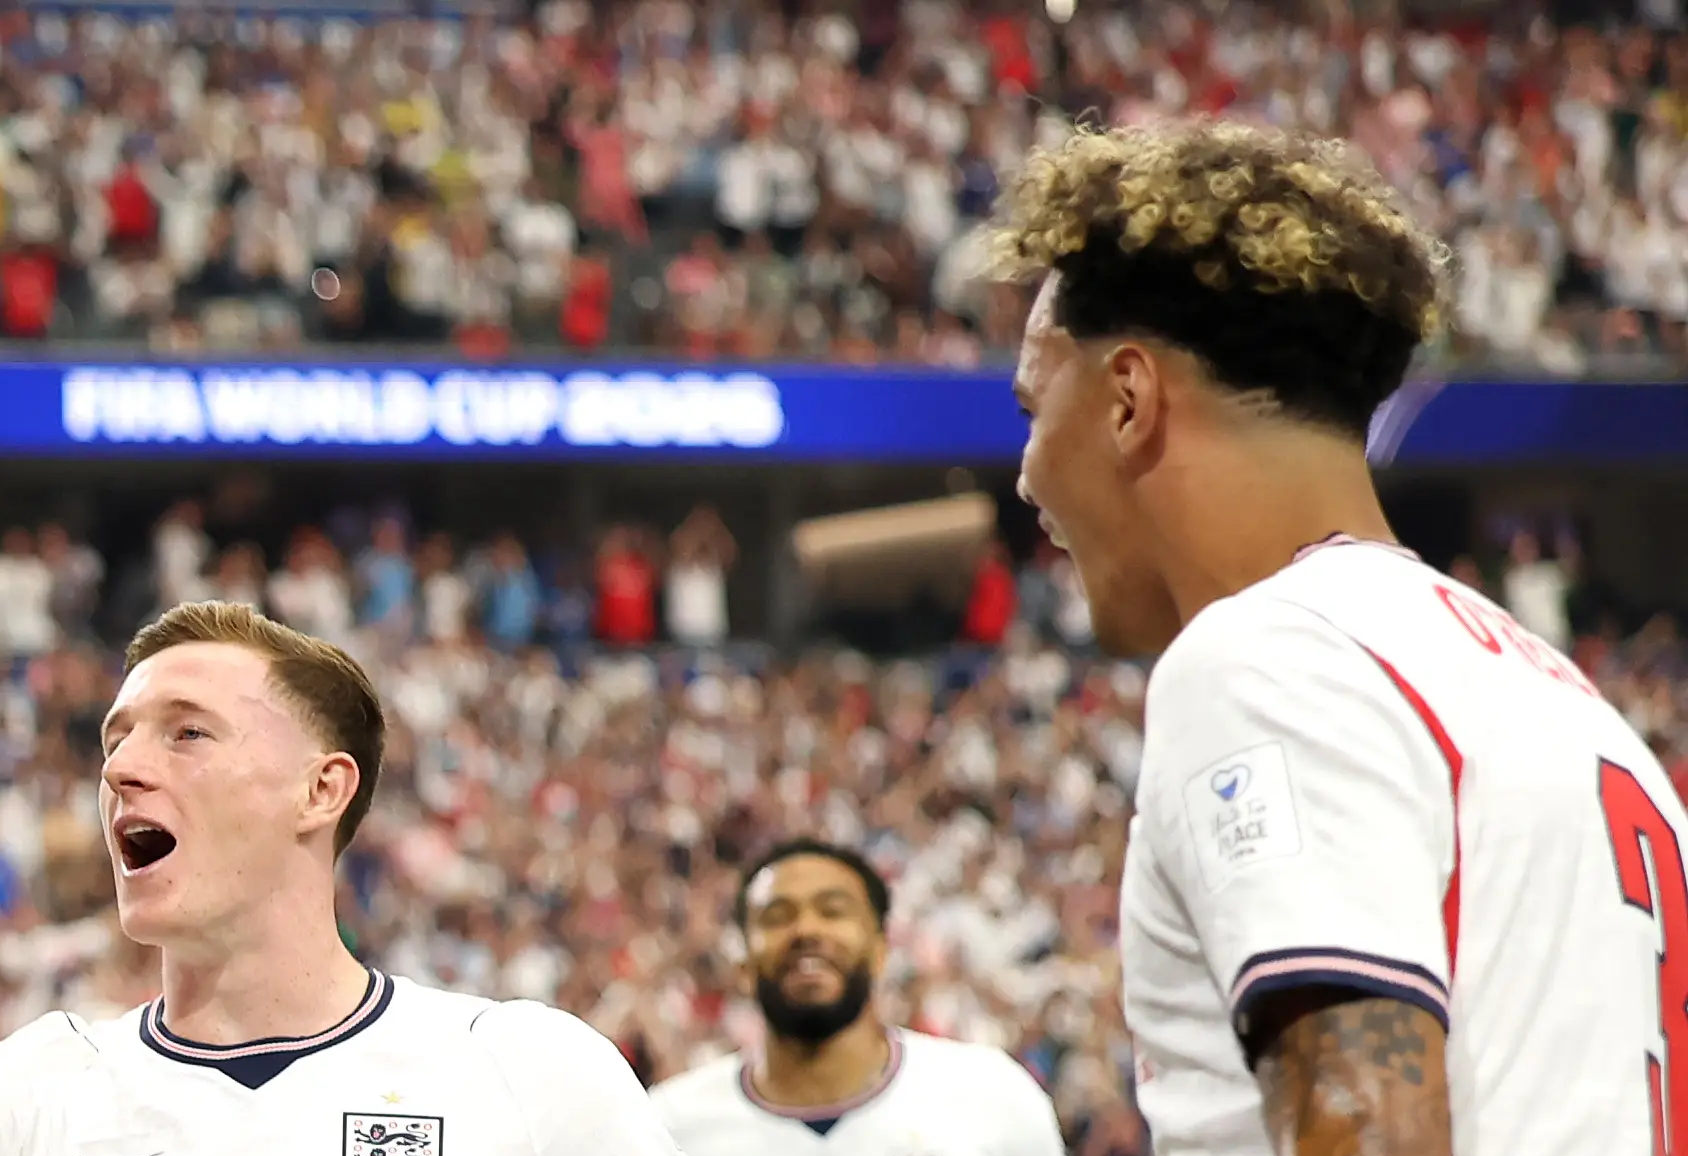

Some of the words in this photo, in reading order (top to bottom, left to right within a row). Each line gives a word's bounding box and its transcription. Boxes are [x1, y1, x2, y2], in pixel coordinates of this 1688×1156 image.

[63, 368, 208, 443] FIFA
[206, 368, 432, 445] WORLD
[434, 369, 559, 445] CUP
